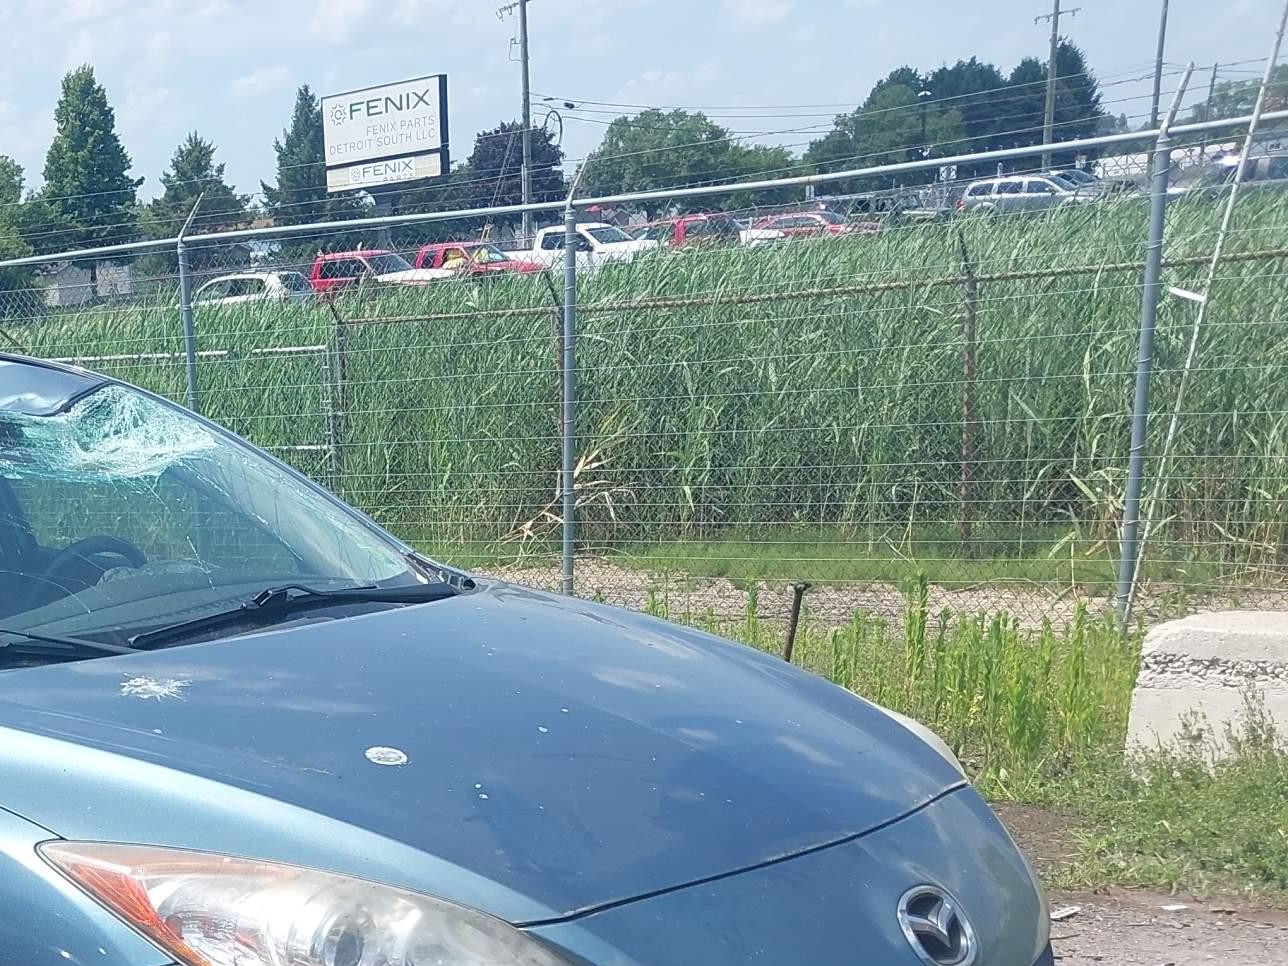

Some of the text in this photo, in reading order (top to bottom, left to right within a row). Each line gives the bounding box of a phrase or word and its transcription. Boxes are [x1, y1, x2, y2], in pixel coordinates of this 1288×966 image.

[349, 89, 430, 120] FENIX
[366, 115, 435, 137] FENIX PARTS
[330, 128, 435, 155] DETROIT SOUTH LLC
[362, 160, 413, 177] FENIX
